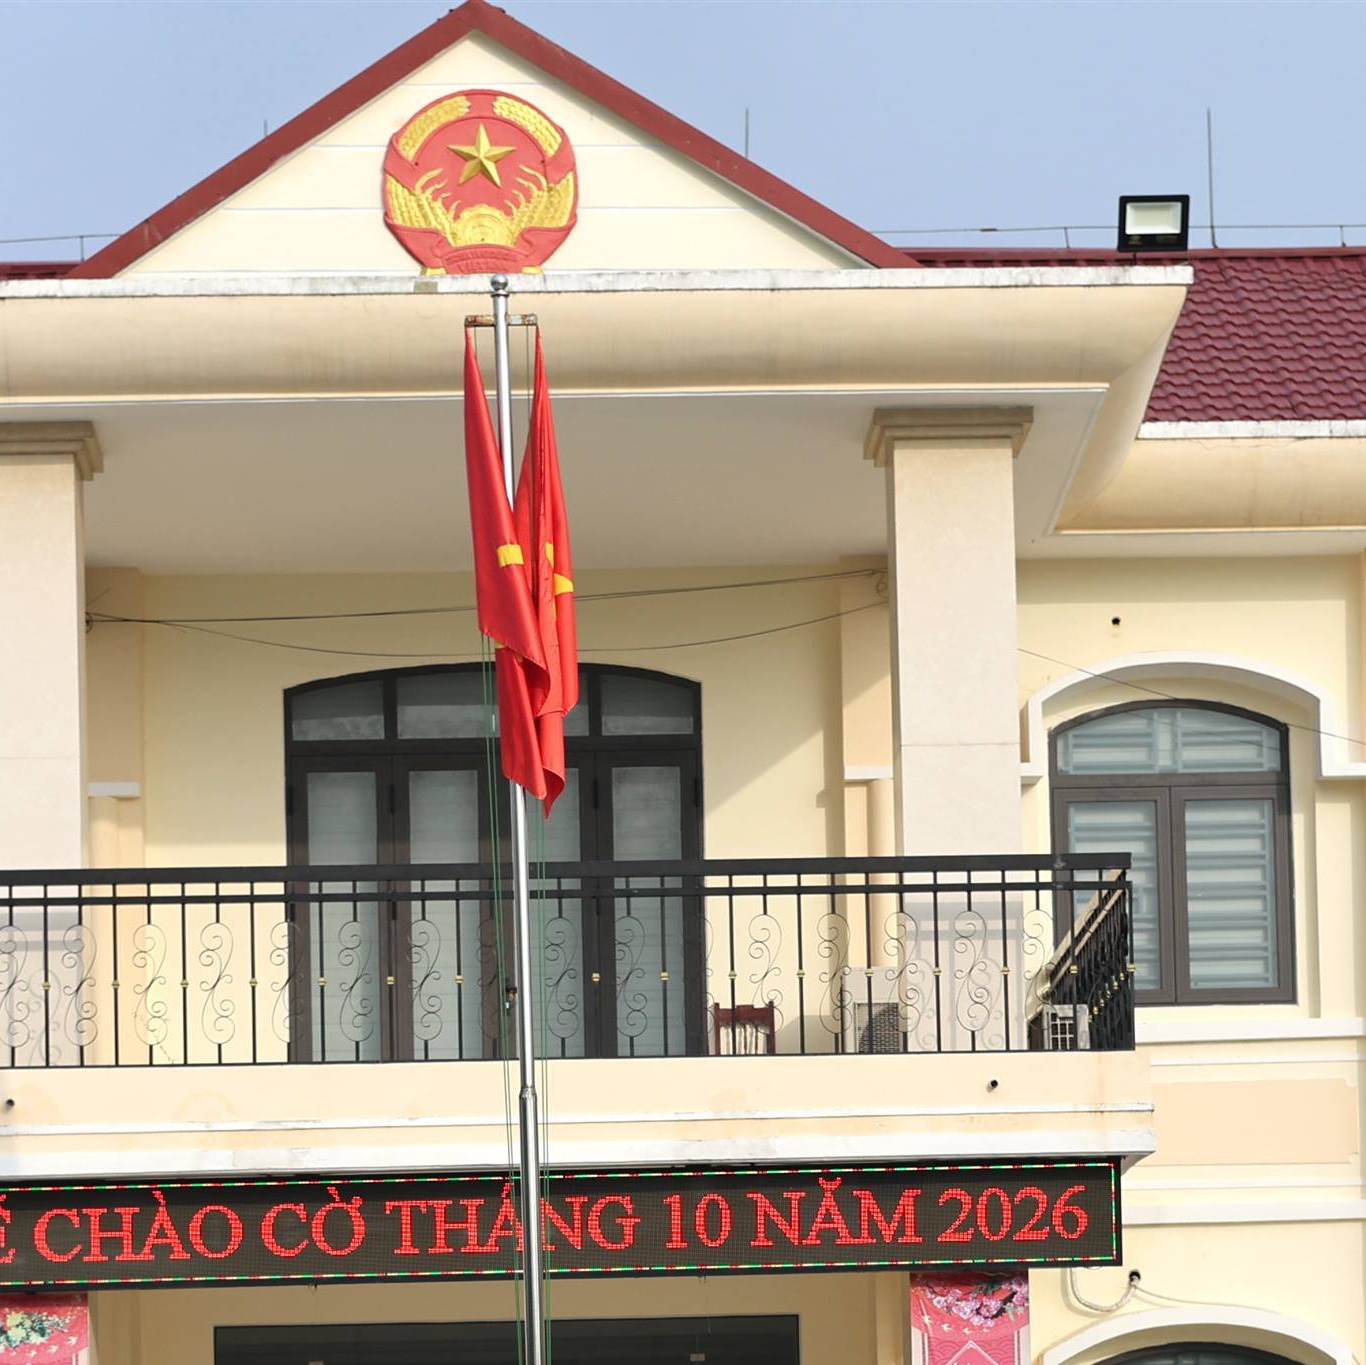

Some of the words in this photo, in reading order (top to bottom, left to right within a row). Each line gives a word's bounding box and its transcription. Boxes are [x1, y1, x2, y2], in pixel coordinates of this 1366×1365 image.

[34, 1190, 245, 1264] CHÀO
[260, 1186, 366, 1257] CỜ
[385, 1182, 641, 1255] THÁNG
[663, 1194, 732, 1250] 10
[747, 1177, 924, 1248] NĂM
[938, 1186, 1090, 1243] 2026
